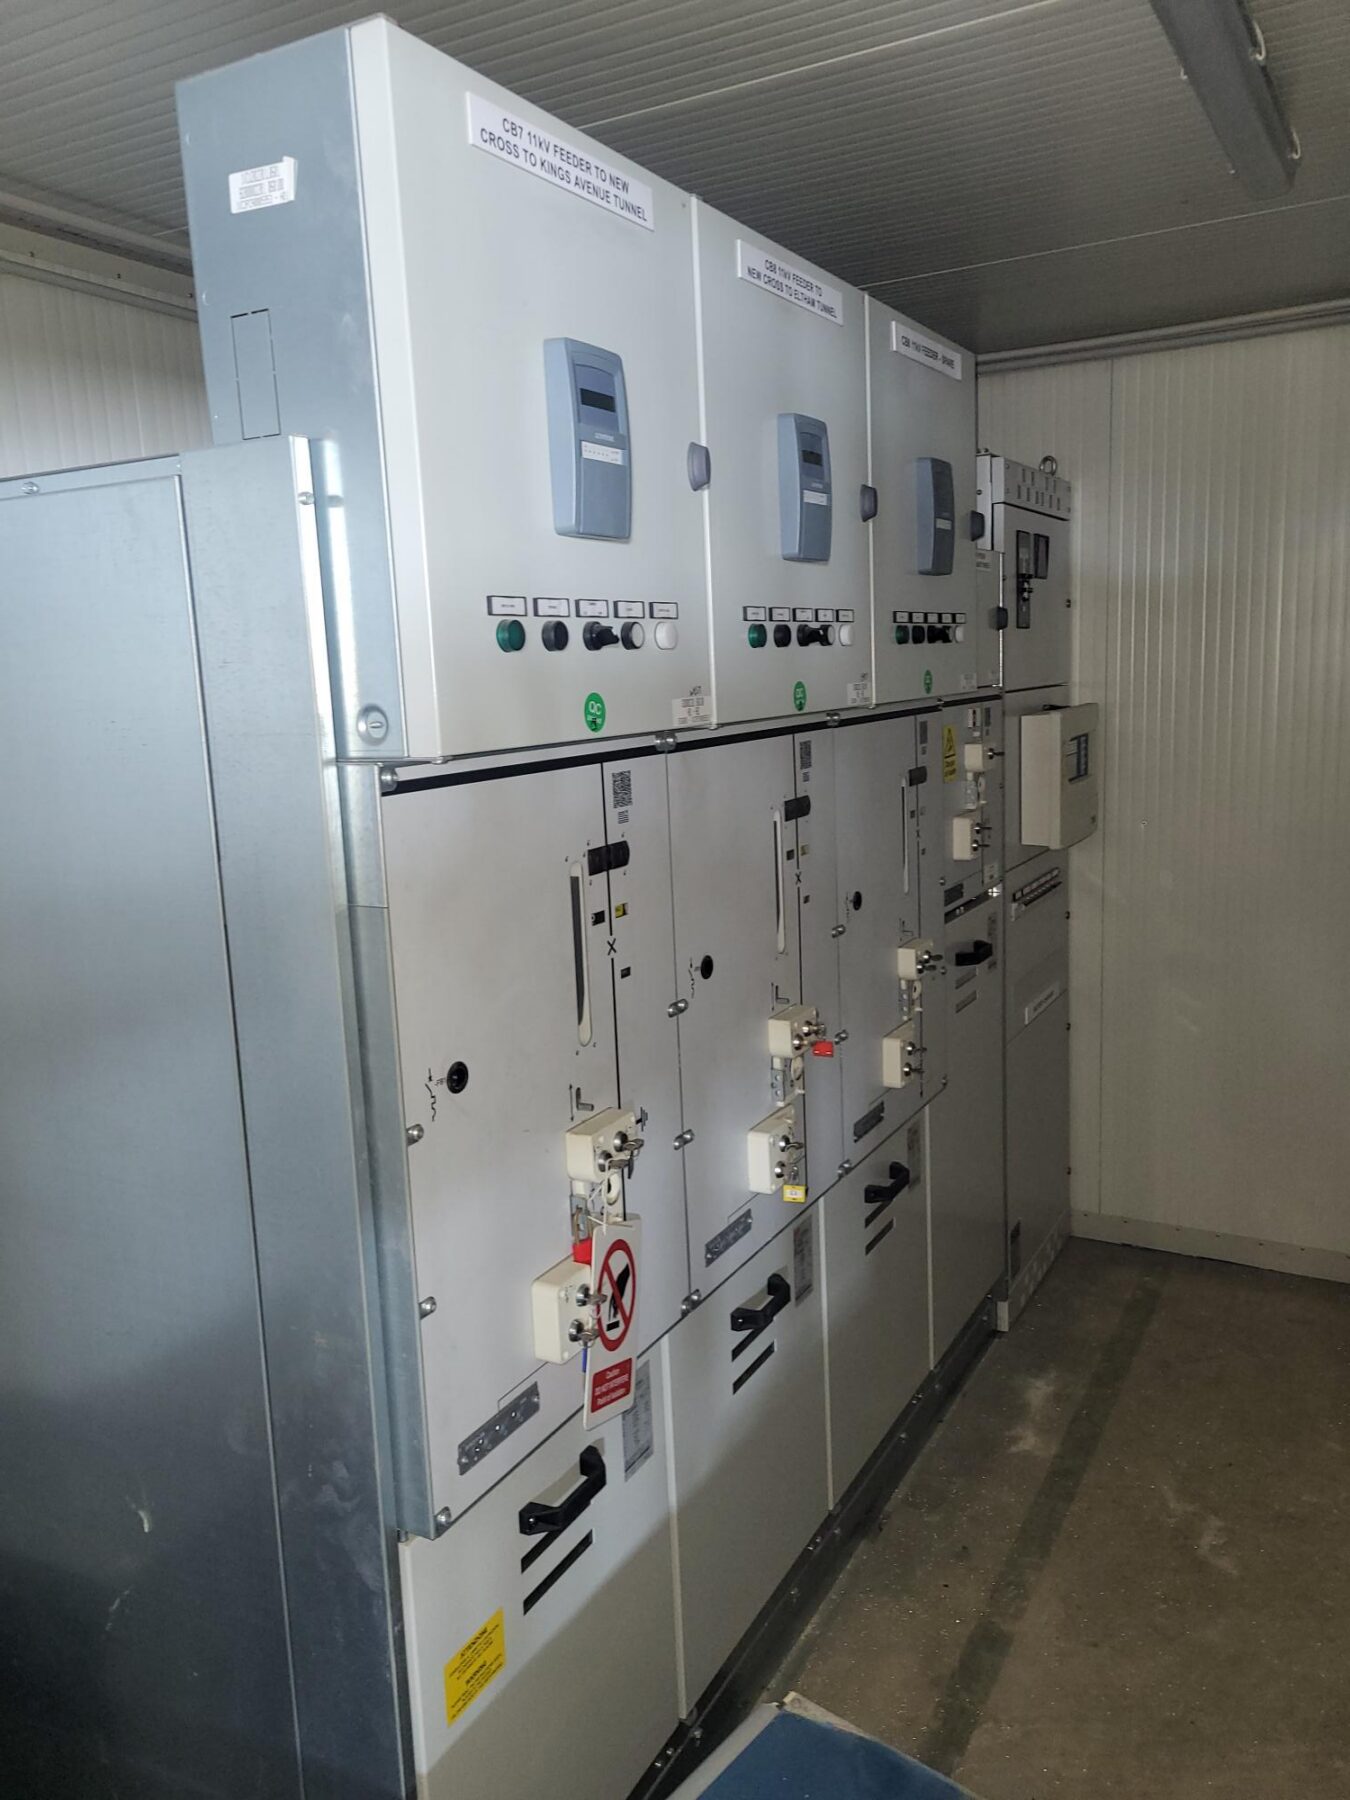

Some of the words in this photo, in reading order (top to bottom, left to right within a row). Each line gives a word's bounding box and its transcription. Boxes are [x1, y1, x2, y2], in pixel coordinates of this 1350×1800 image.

[480, 128, 520, 159] CROSS
[522, 148, 537, 167] TO
[540, 157, 571, 184] KINGS
[574, 175, 611, 205] AVENUE
[613, 193, 648, 222] TUNNEL
[503, 118, 523, 139] CB7
[528, 131, 550, 153] 11kV
[553, 144, 592, 176] FEEDER
[594, 165, 607, 182] TO
[609, 173, 630, 195] NEW
[747, 266, 761, 281] NEW
[763, 273, 784, 293] CROSS
[785, 284, 793, 298] TO
[792, 273, 814, 293] FEEDER
[815, 284, 823, 298] TO
